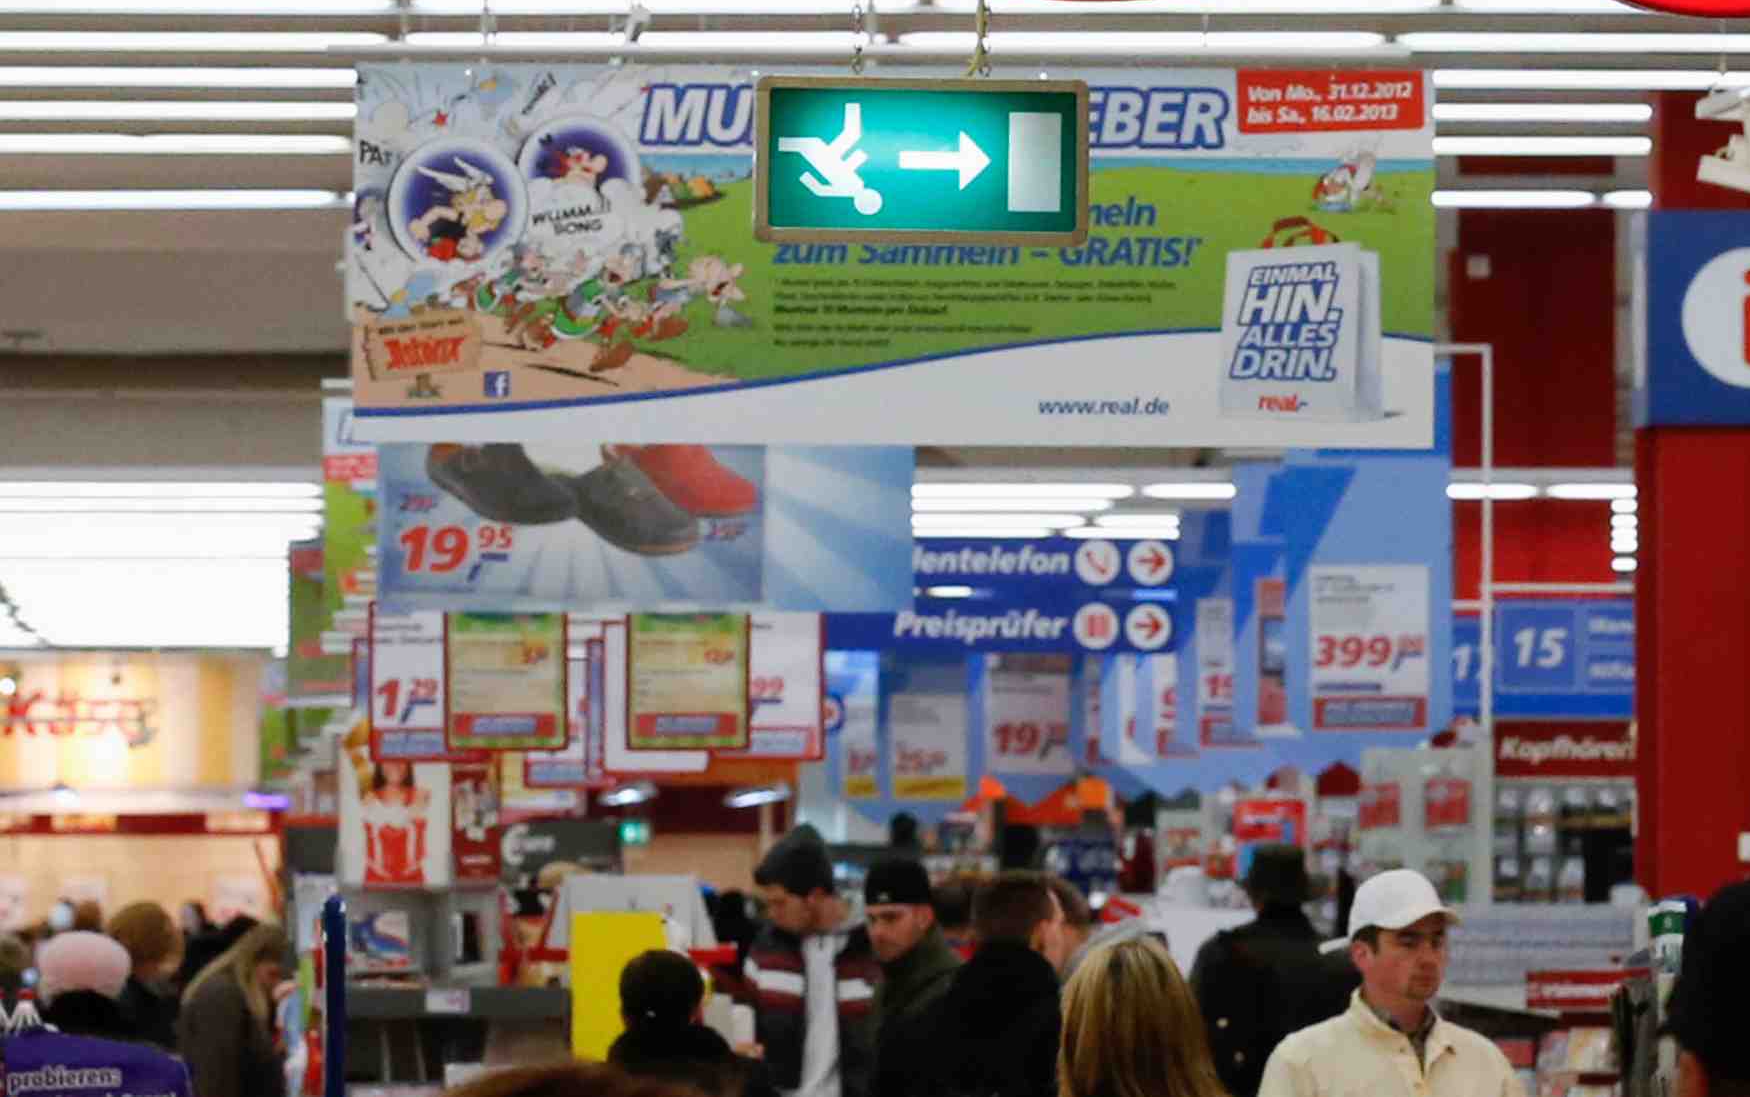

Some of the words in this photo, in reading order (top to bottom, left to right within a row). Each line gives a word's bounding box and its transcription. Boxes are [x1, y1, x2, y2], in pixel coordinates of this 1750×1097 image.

[1248, 84, 1282, 103] Von
[1248, 106, 1273, 124] bis
[772, 244, 848, 265] zum
[1250, 261, 1339, 287] EINMAL
[1238, 280, 1343, 327] HIN.
[1240, 323, 1338, 349] ALLES
[1229, 347, 1339, 383] DRIN.
[1038, 397, 1170, 415] www.real.de
[894, 609, 1069, 644] Preisprüfer
[1514, 626, 1569, 668] 15
